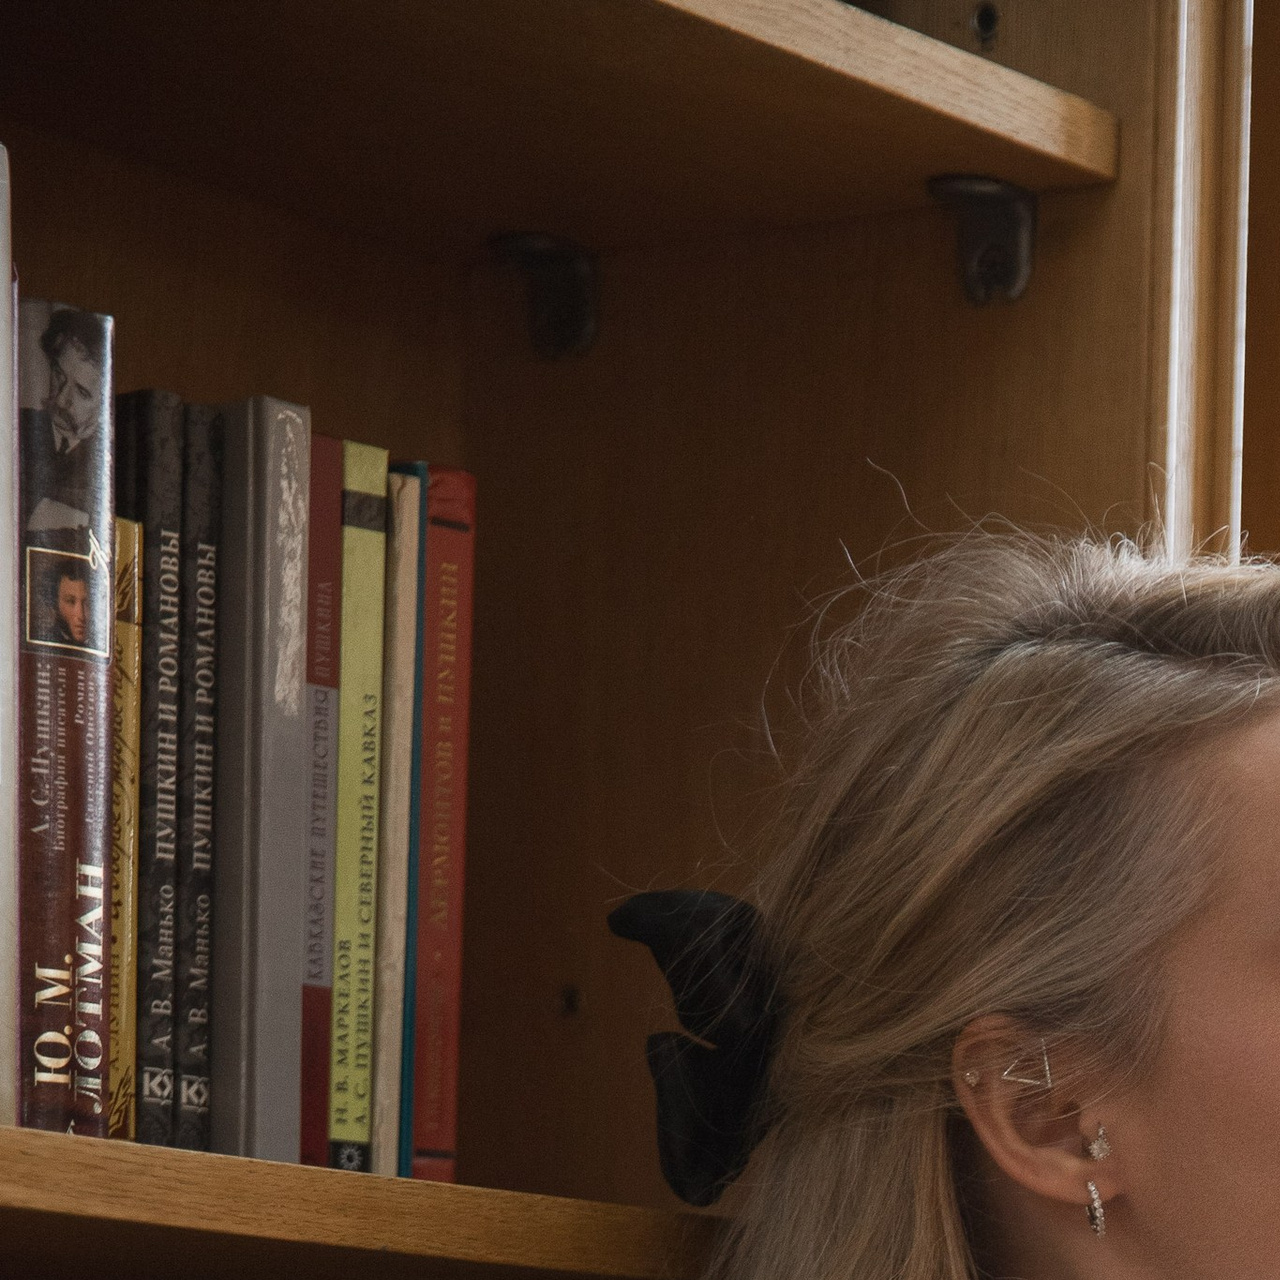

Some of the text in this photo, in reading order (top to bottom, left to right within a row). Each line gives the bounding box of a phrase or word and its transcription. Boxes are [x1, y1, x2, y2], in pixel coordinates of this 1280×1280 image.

[435, 562, 459, 704] ПУШКИН
[150, 528, 180, 1052] А. В. Манько ПУШКИН И РОМАНОВЫ
[188, 541, 217, 1060] А. В. Манько ПУШКИН И РОМАНОВЫ
[353, 693, 377, 1126] А. С. ПУШКИН И СЕВЕРНЫЙ КАВКАЗ
[34, 953, 72, 1090] Ю. М.
[75, 858, 103, 1114] ЛОТМАН
[334, 939, 352, 1126] Н. В. МАРКЕЛОВ
